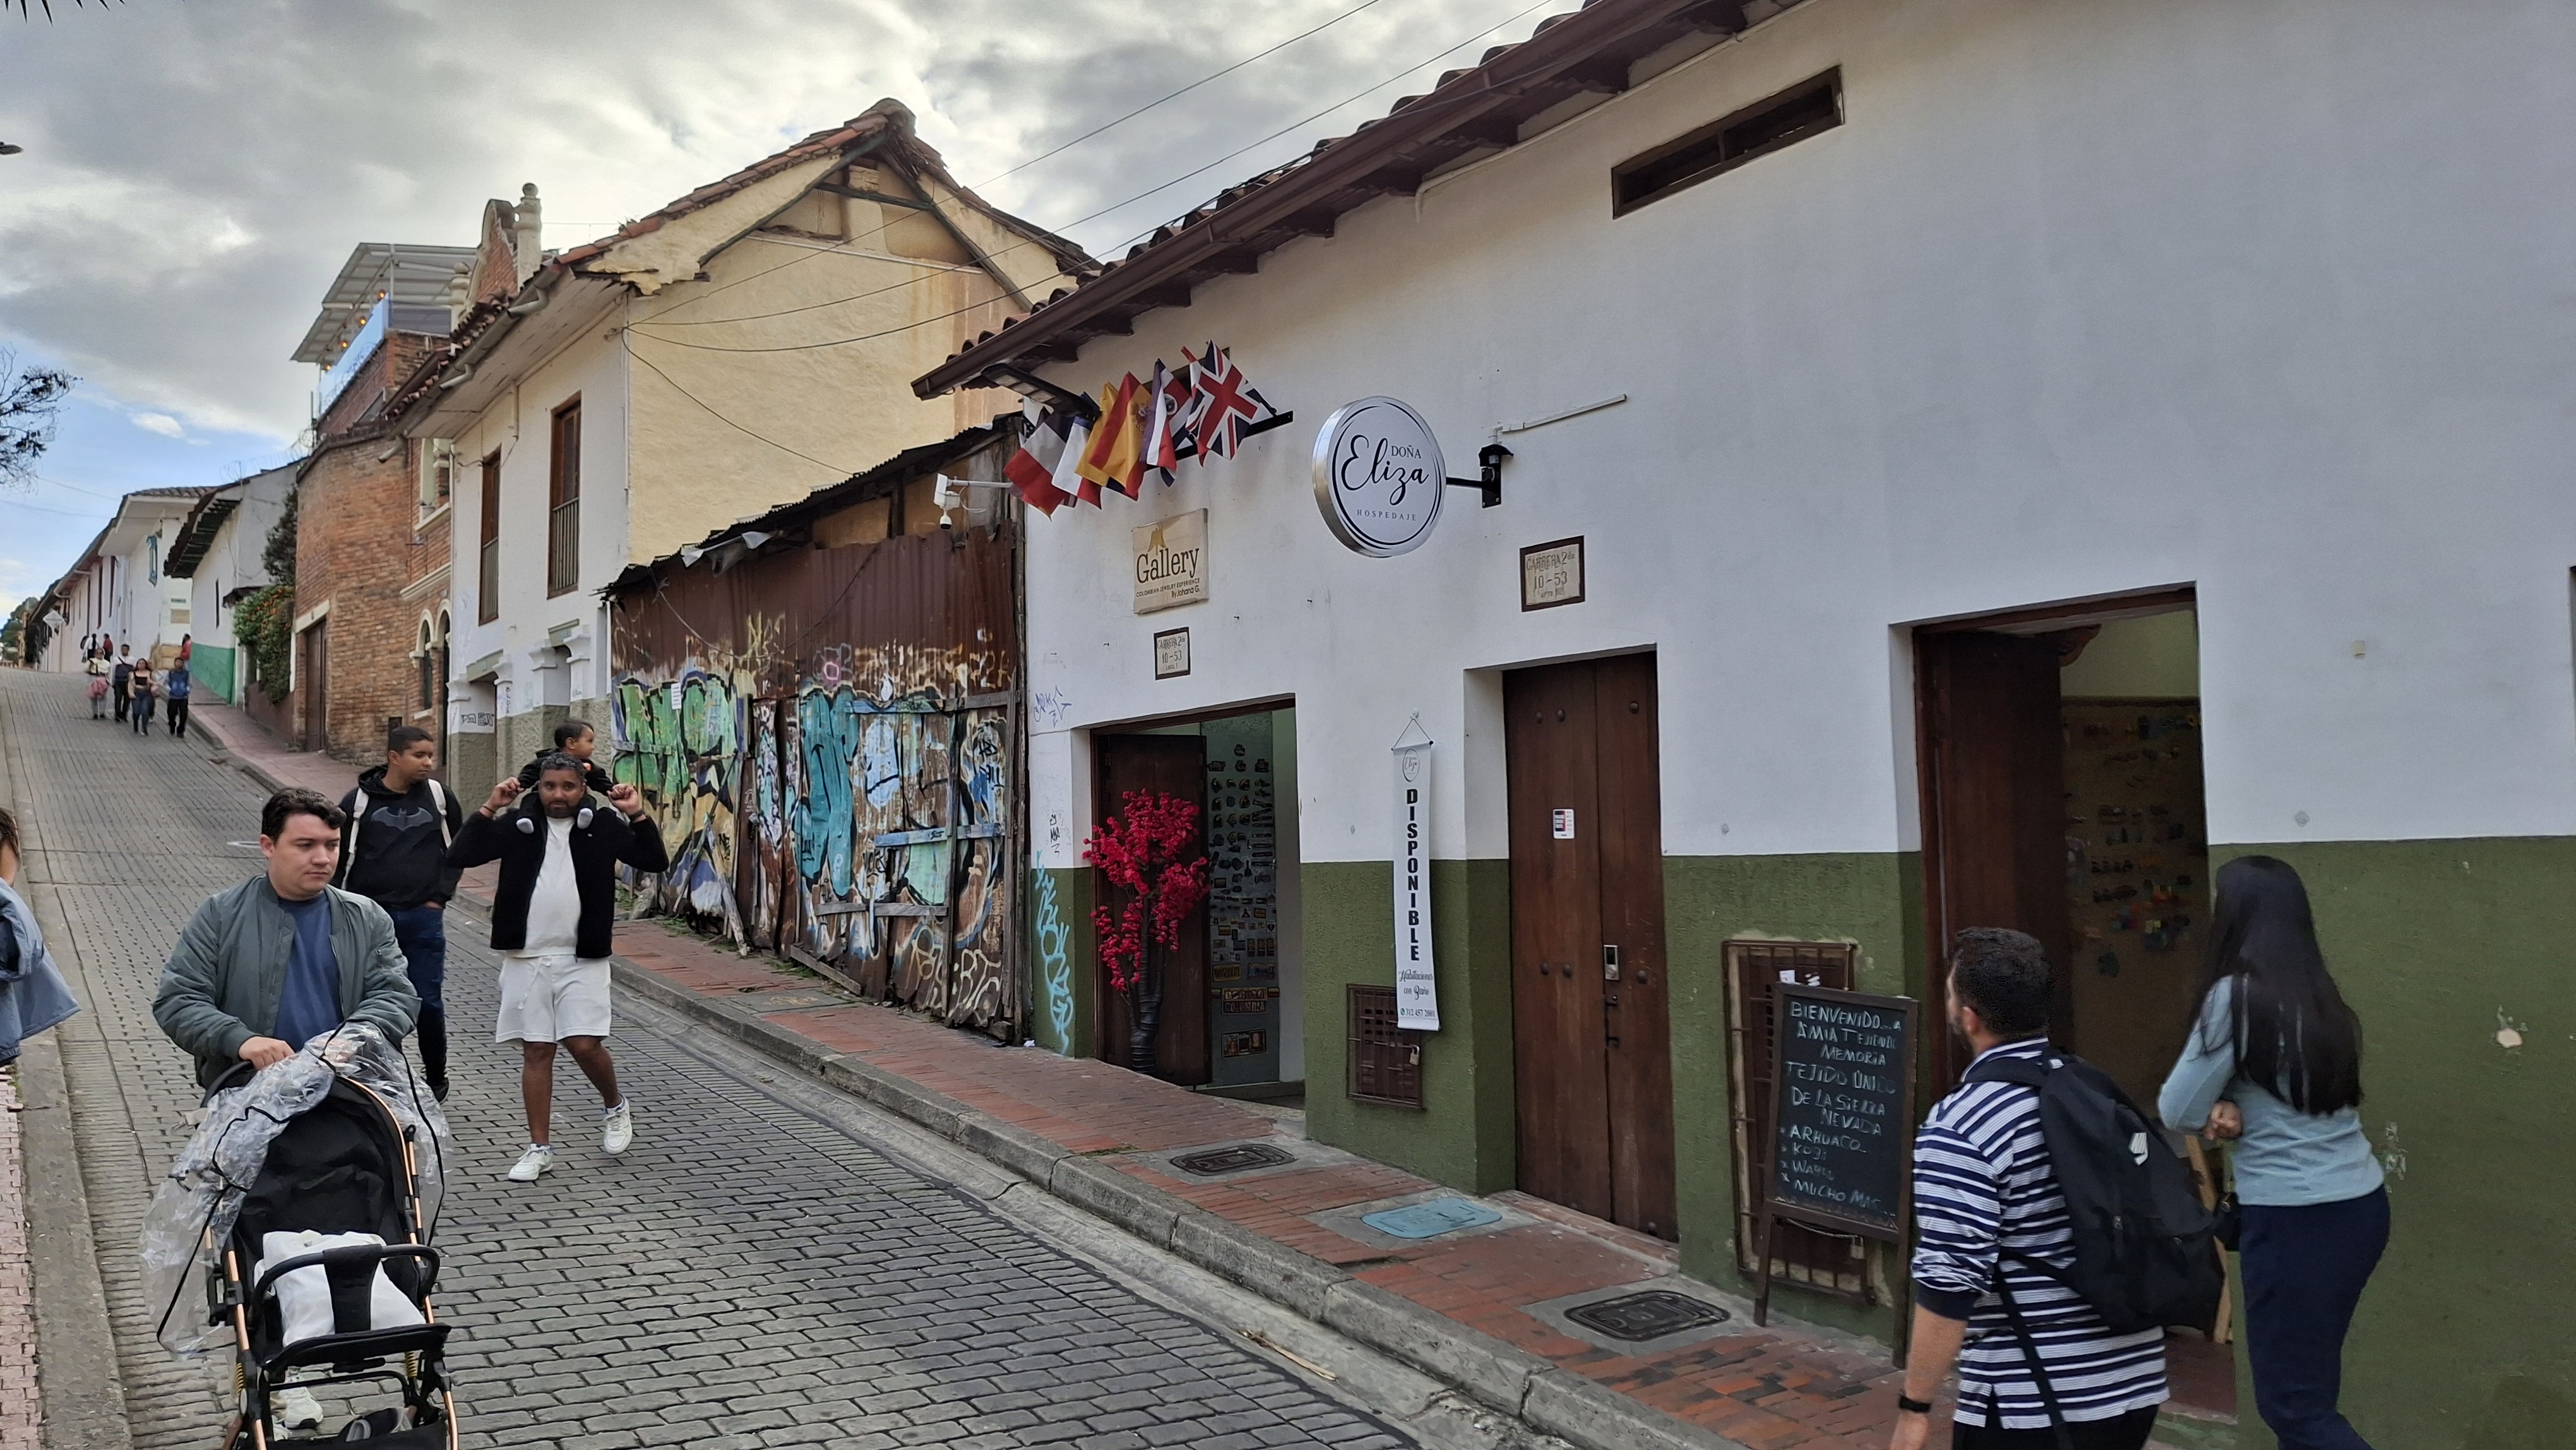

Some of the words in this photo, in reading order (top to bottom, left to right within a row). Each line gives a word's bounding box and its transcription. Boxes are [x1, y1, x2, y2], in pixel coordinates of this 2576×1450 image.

[1391, 445, 1421, 458] DOÑA
[1341, 434, 1429, 505] Eliza
[1357, 509, 1416, 521] HOSPEDAJE
[1136, 548, 1200, 584] Gallery
[1526, 554, 1561, 572] CARRERA
[1136, 588, 1159, 597] COLOMBIAN
[1160, 583, 1176, 592] JEWELRY
[1177, 578, 1200, 588] EXPERIENCE
[1172, 590, 1177, 599] By
[1177, 587, 1194, 597] Johana
[1157, 637, 1178, 650] CARRERA
[1406, 789, 1420, 961] DISPONIBLE
[1785, 1061, 1848, 1086] TEJIDO
[1791, 1086, 1812, 1106] DE
[1815, 1088, 1832, 1108] LA
[1821, 1107, 1882, 1136] NEVADA
[1794, 1179, 1847, 1202] MUCHO
